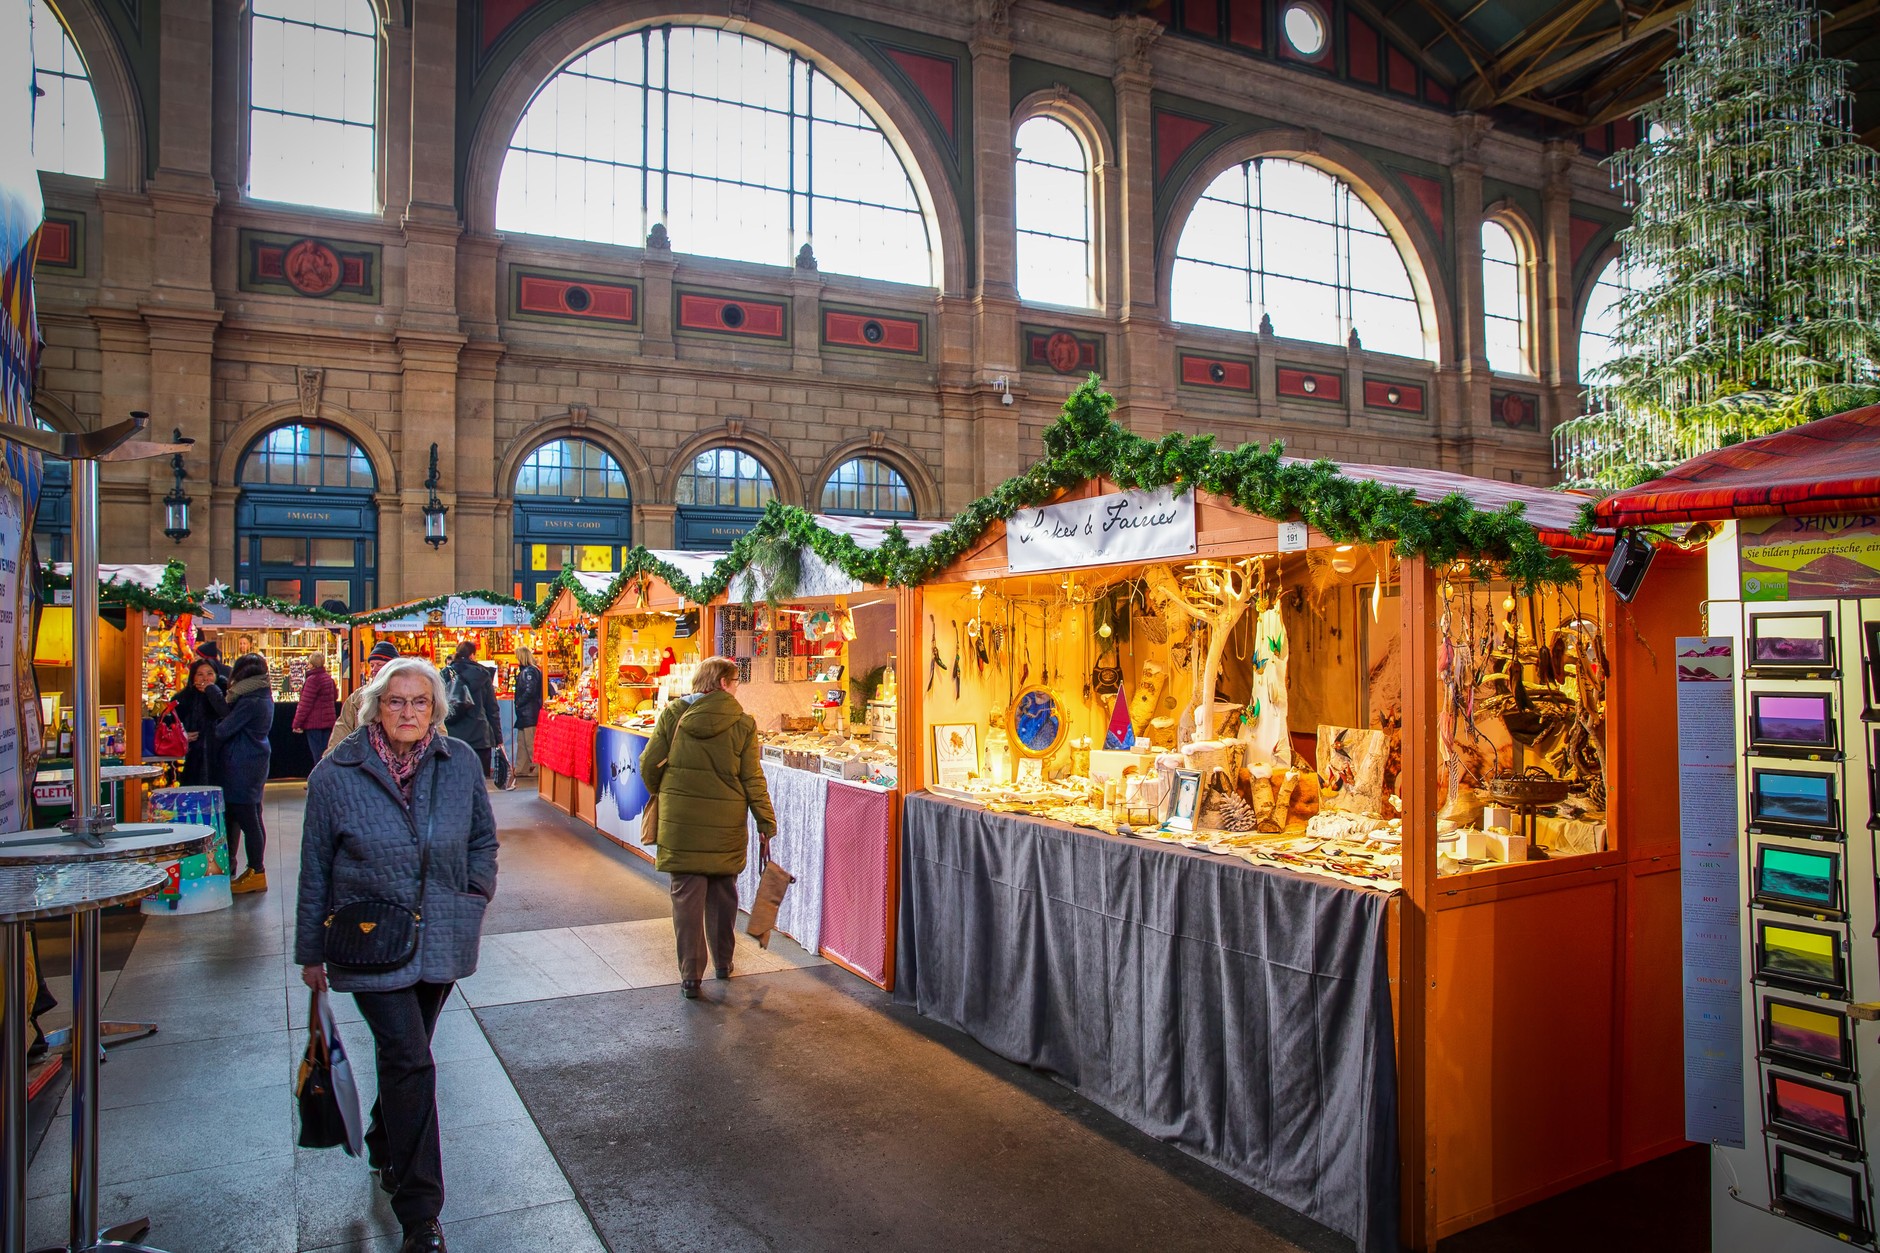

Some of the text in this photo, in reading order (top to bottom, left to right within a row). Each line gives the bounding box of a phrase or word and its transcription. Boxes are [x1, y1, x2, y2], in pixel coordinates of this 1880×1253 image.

[287, 511, 331, 520] IMAGINE
[1084, 514, 1093, 536] &
[1102, 499, 1177, 532] Fairies
[544, 520, 573, 528] TASTES
[711, 527, 747, 535] IMAGINE
[1287, 533, 1298, 542] 191
[1746, 548, 1760, 559] Sie
[1762, 546, 1790, 558] bilden
[1792, 541, 1863, 559] phantastische,
[466, 607, 498, 616] TEDDY'S
